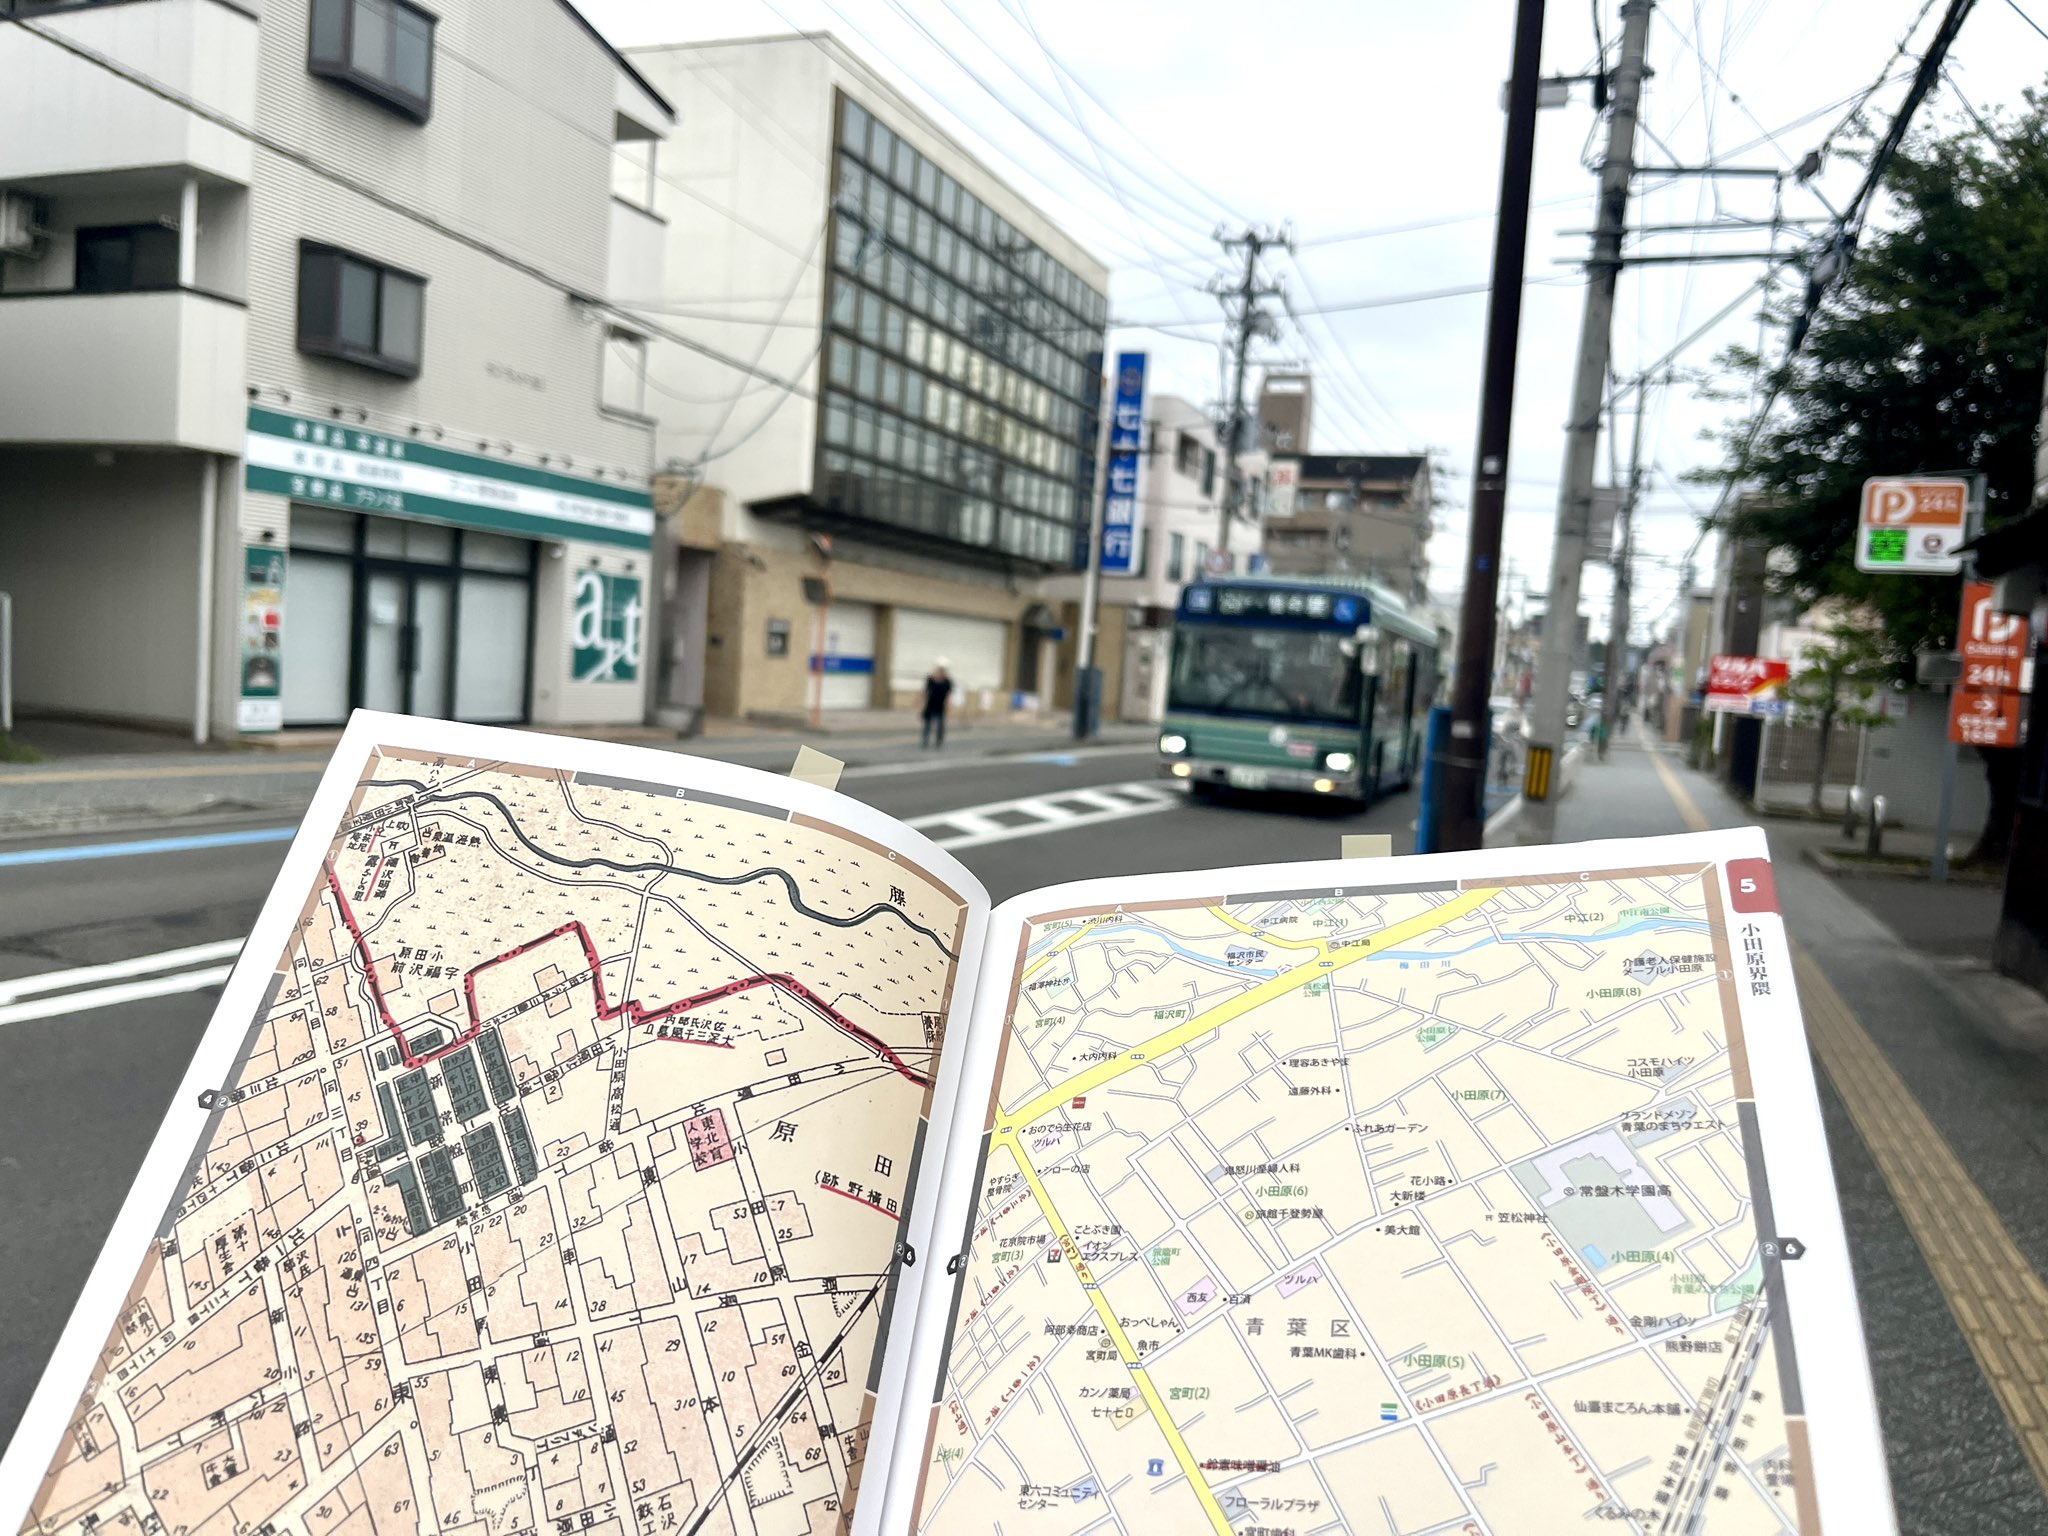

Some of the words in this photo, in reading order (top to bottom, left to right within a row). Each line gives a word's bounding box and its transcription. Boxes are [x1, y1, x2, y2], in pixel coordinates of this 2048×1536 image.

[467, 759, 476, 768] A
[676, 789, 685, 798] B
[1580, 872, 1590, 881] C
[1740, 878, 1757, 893] 5
[1335, 888, 1344, 897] B
[1115, 905, 1123, 914] A
[1741, 923, 1771, 997] 小田原界隈
[1586, 987, 1642, 999] 小田原(8)
[325, 1006, 338, 1016] 58
[1153, 1009, 1186, 1020] 福沢町
[1627, 1055, 1696, 1068] コスモハイツ
[1450, 1089, 1506, 1101] 小田原(7)
[1620, 1110, 1698, 1121] グランドメゾン
[1028, 1122, 1092, 1135] おのでら生花店
[1410, 1176, 1446, 1187] 花小路
[1255, 1186, 1308, 1198] 小田原(6)
[1578, 1184, 1672, 1198] 常盤木学園高
[513, 1205, 527, 1216] 20
[733, 1208, 748, 1219] 53
[489, 1216, 503, 1228] 22
[572, 1216, 587, 1229] 32
[1498, 1212, 1549, 1224] 笠松神社
[778, 1228, 793, 1239] 25
[539, 1233, 554, 1247] 23
[991, 1250, 1024, 1264] 宮町(3)
[1082, 1252, 1139, 1262] エクスプレス
[1611, 1250, 1675, 1263] 小田原(4)
[388, 1270, 400, 1281] 12
[754, 1272, 767, 1283] 10
[1186, 1293, 1208, 1303] 西友
[455, 1303, 468, 1315] 15
[590, 1300, 607, 1312] 38
[704, 1320, 718, 1333] 12
[1119, 1317, 1179, 1329] おっぺしゃん
[600, 1340, 613, 1352] 41
[665, 1339, 681, 1352] 29
[1137, 1340, 1159, 1351] 魚市
[566, 1351, 580, 1362] 12
[1086, 1350, 1118, 1361] 宮町局
[1290, 1346, 1357, 1359] 青葉MK歯科
[365, 1358, 382, 1371] 59
[1403, 1354, 1465, 1369] 小田原(5)
[721, 1371, 736, 1382] 10
[781, 1365, 796, 1377] 60
[826, 1369, 841, 1380] 20
[414, 1376, 429, 1388] 55
[611, 1390, 625, 1403] 45
[1079, 1387, 1132, 1399] カンノ薬局
[1169, 1387, 1210, 1400] 宮町(2)
[375, 1398, 388, 1412] 61
[791, 1411, 807, 1425] 64
[384, 1442, 399, 1457] 63
[624, 1441, 637, 1454] 52
[805, 1447, 821, 1460] 68
[274, 1449, 292, 1462] 23
[632, 1479, 646, 1493] 53
[394, 1500, 410, 1514] 67
[444, 1510, 462, 1525] 46
